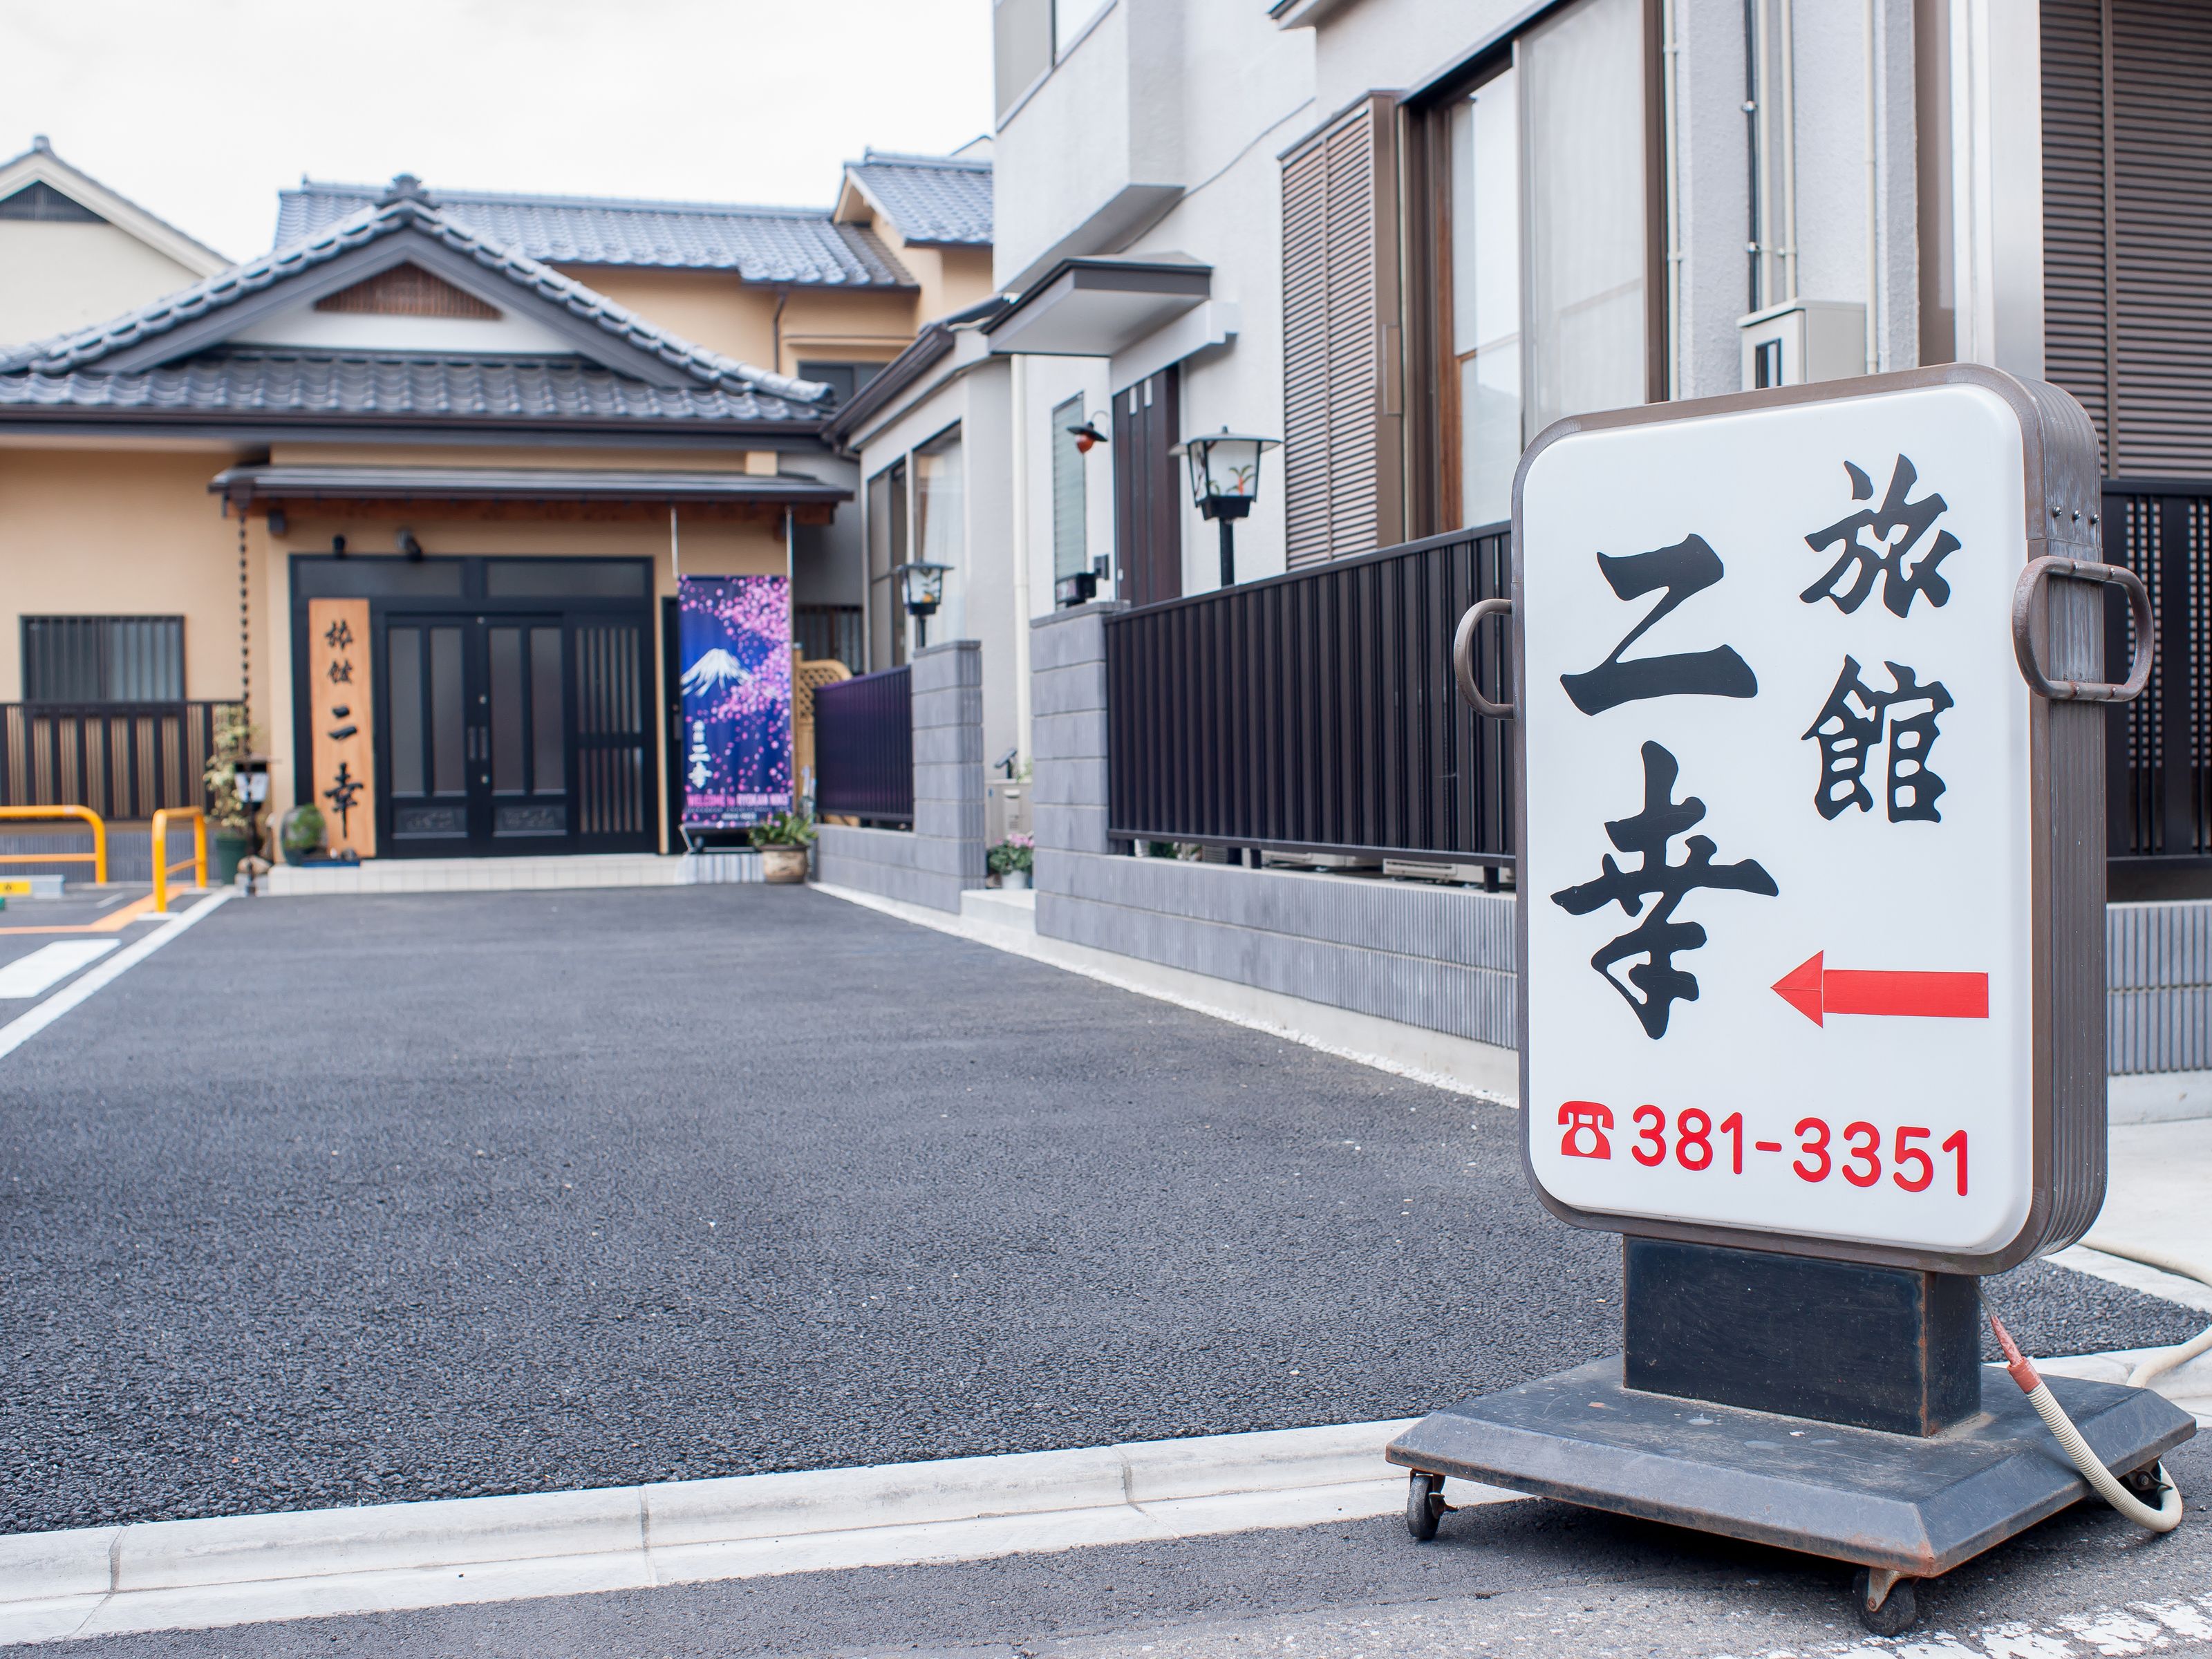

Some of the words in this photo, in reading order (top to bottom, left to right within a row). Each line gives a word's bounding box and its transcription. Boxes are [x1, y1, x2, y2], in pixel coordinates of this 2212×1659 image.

[1550, 533, 1779, 1040] 二幸
[1799, 453, 1961, 823] 旅館
[1631, 1104, 1968, 1197] 381-3351
